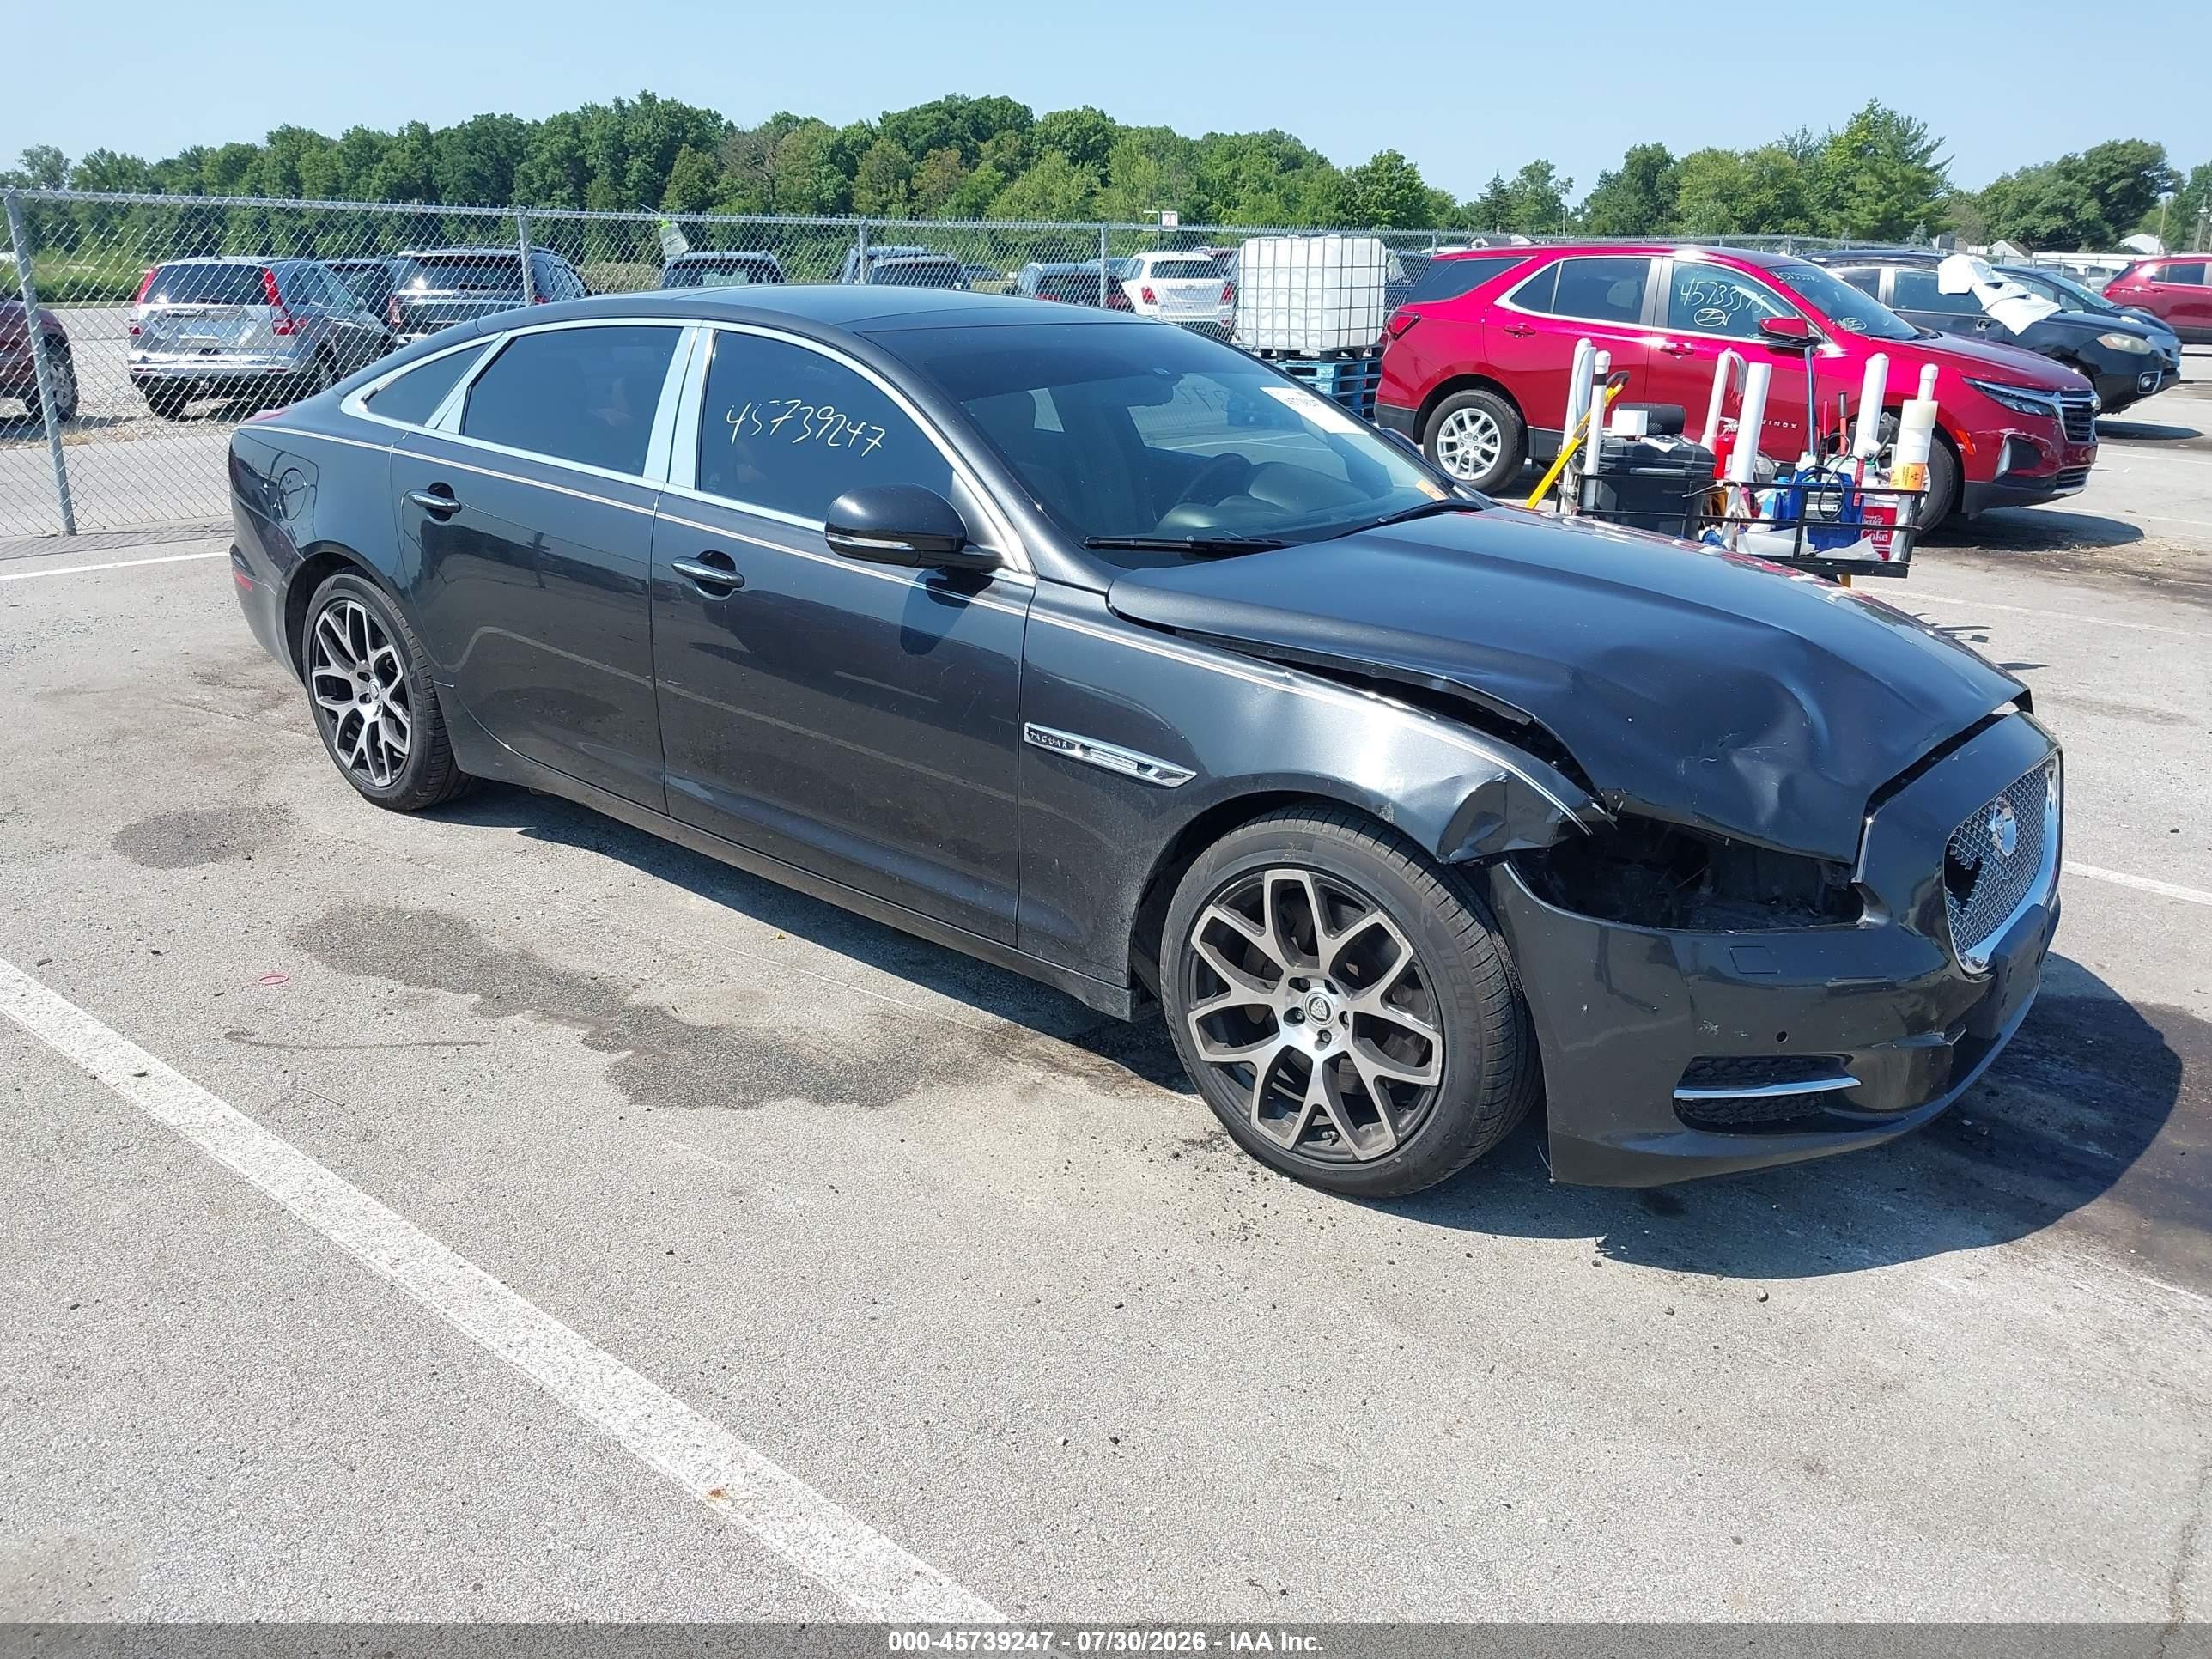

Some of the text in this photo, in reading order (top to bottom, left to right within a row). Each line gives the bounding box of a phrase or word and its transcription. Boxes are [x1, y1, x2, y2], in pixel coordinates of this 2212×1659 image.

[726, 399, 886, 457] 45739247
[1761, 419, 1797, 429] UINOX
[1860, 529, 1889, 542] Coke
[1029, 731, 1067, 749] JAGUAR
